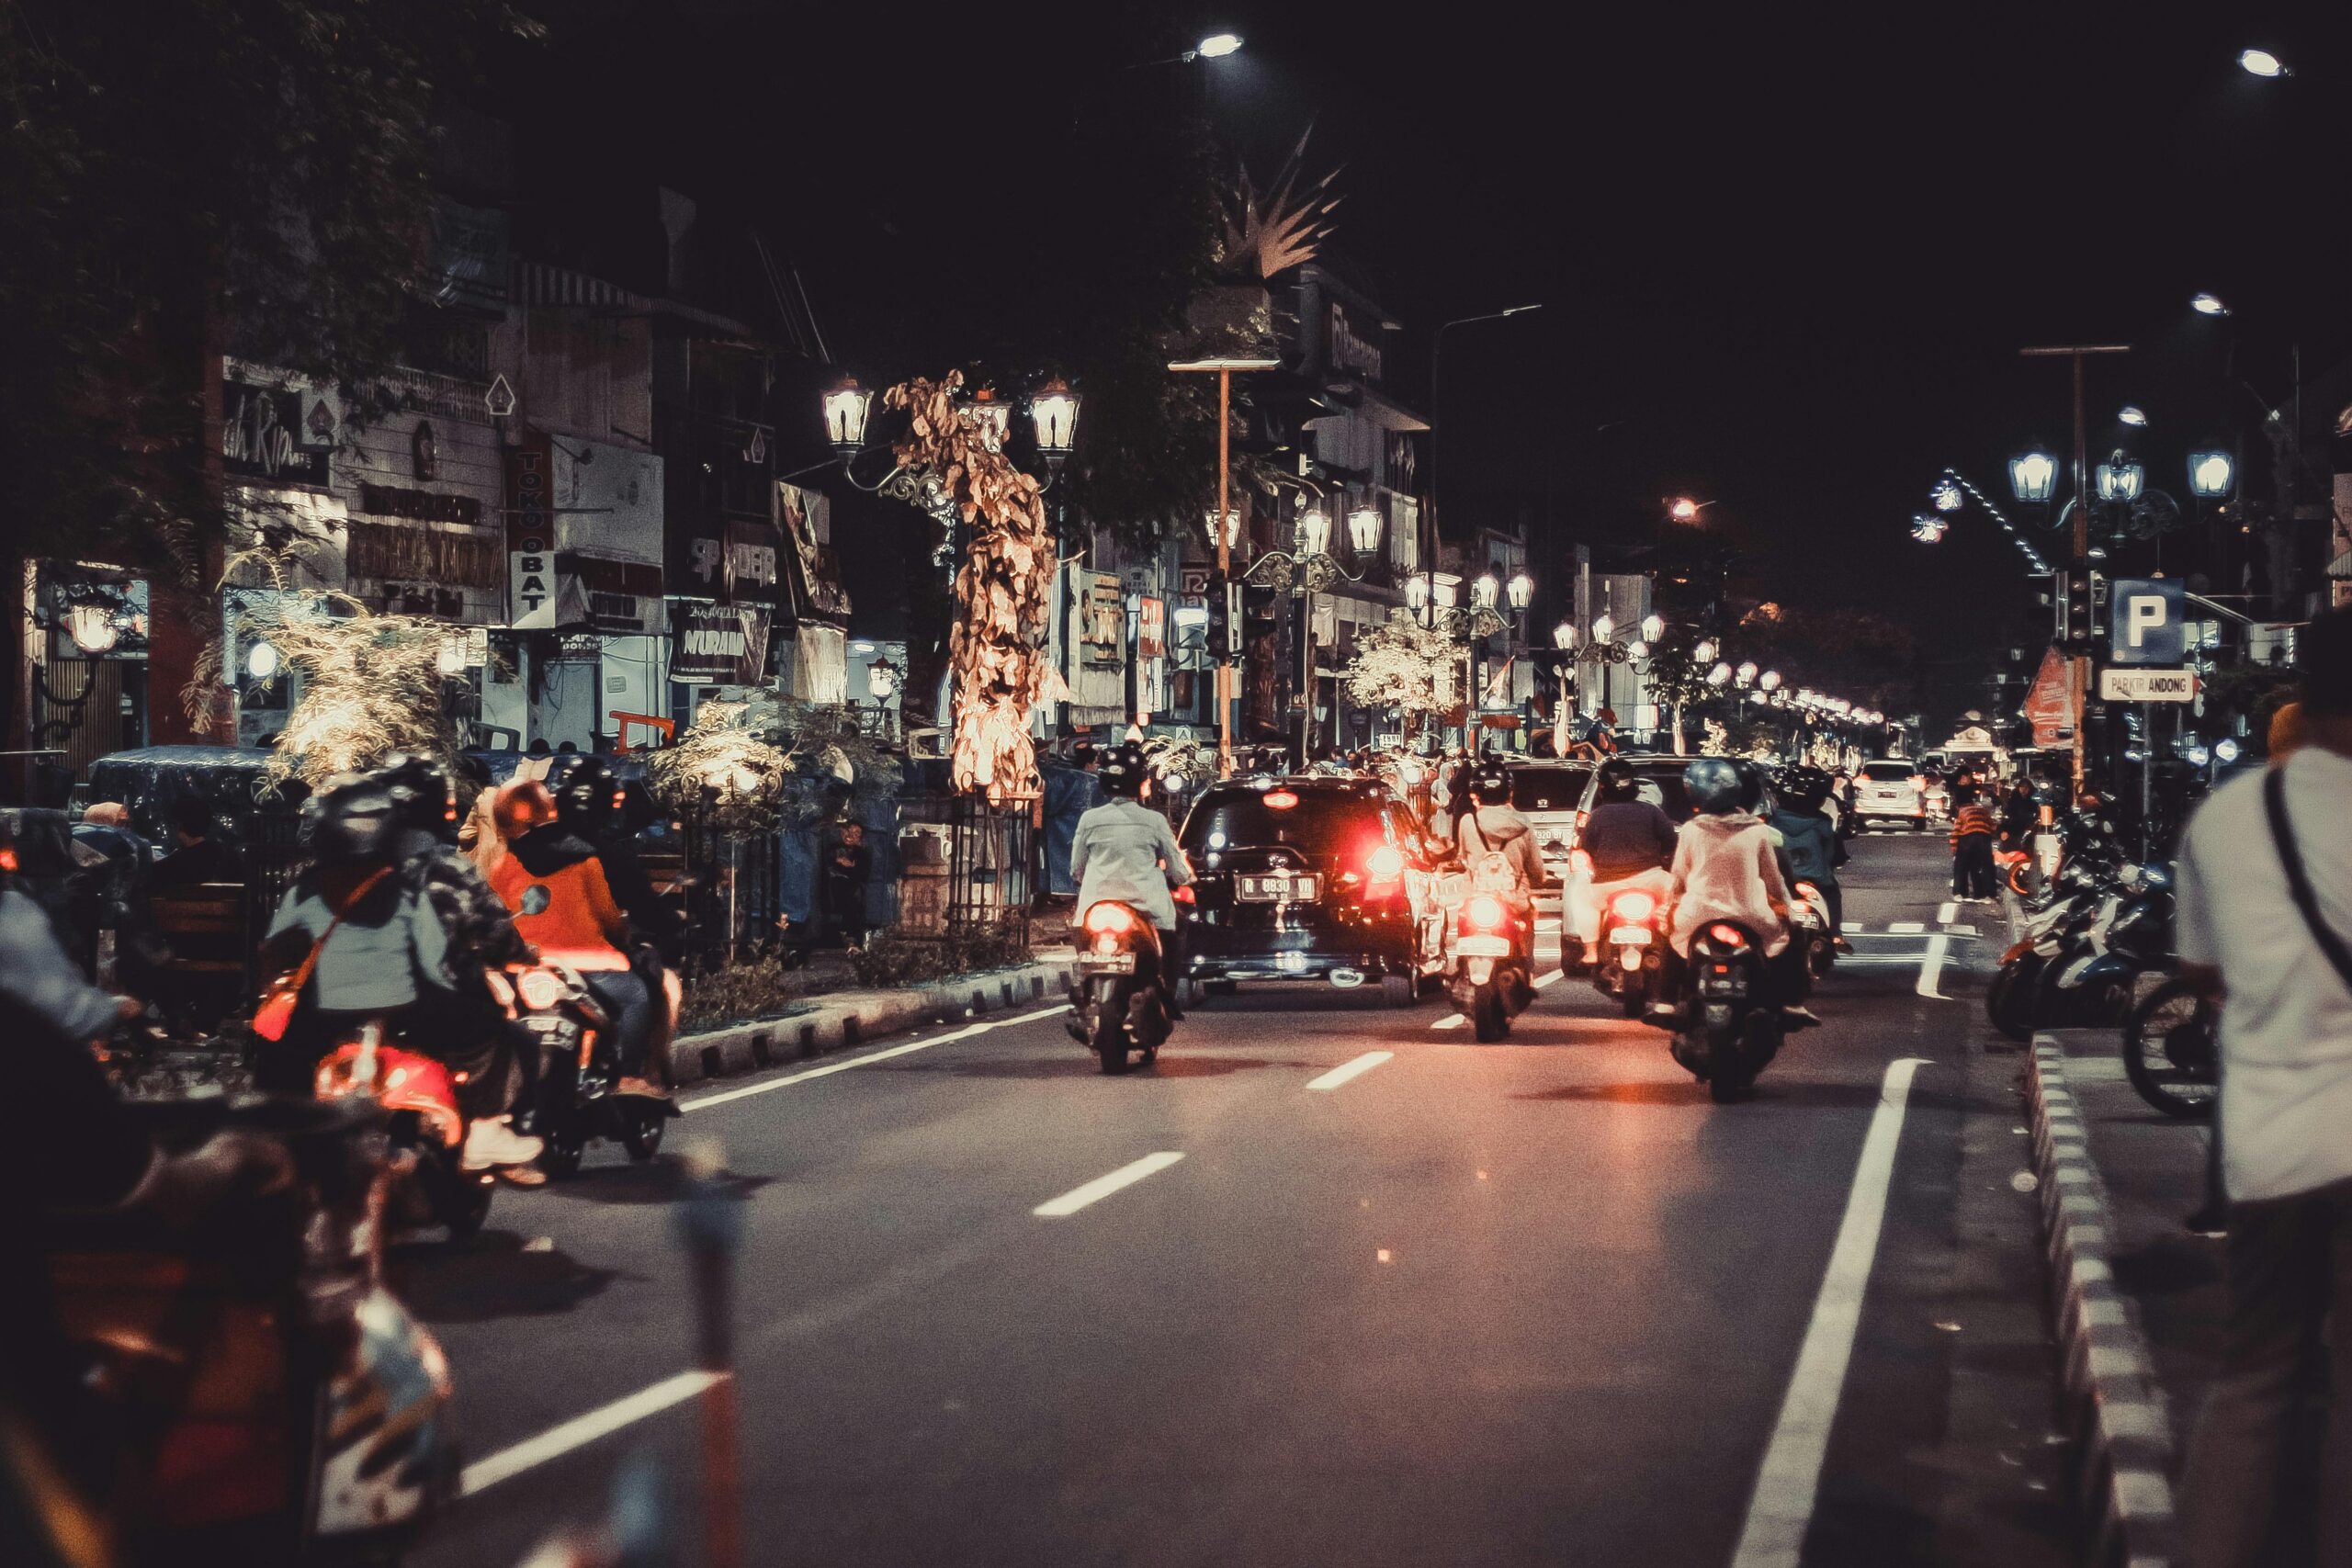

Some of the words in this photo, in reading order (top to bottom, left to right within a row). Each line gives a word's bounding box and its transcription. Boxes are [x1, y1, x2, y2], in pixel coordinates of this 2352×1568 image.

[518, 452, 544, 530] TOKO
[521, 536, 546, 612] OBAT
[2129, 595, 2166, 647] P
[2148, 677, 2187, 693] ANDONG
